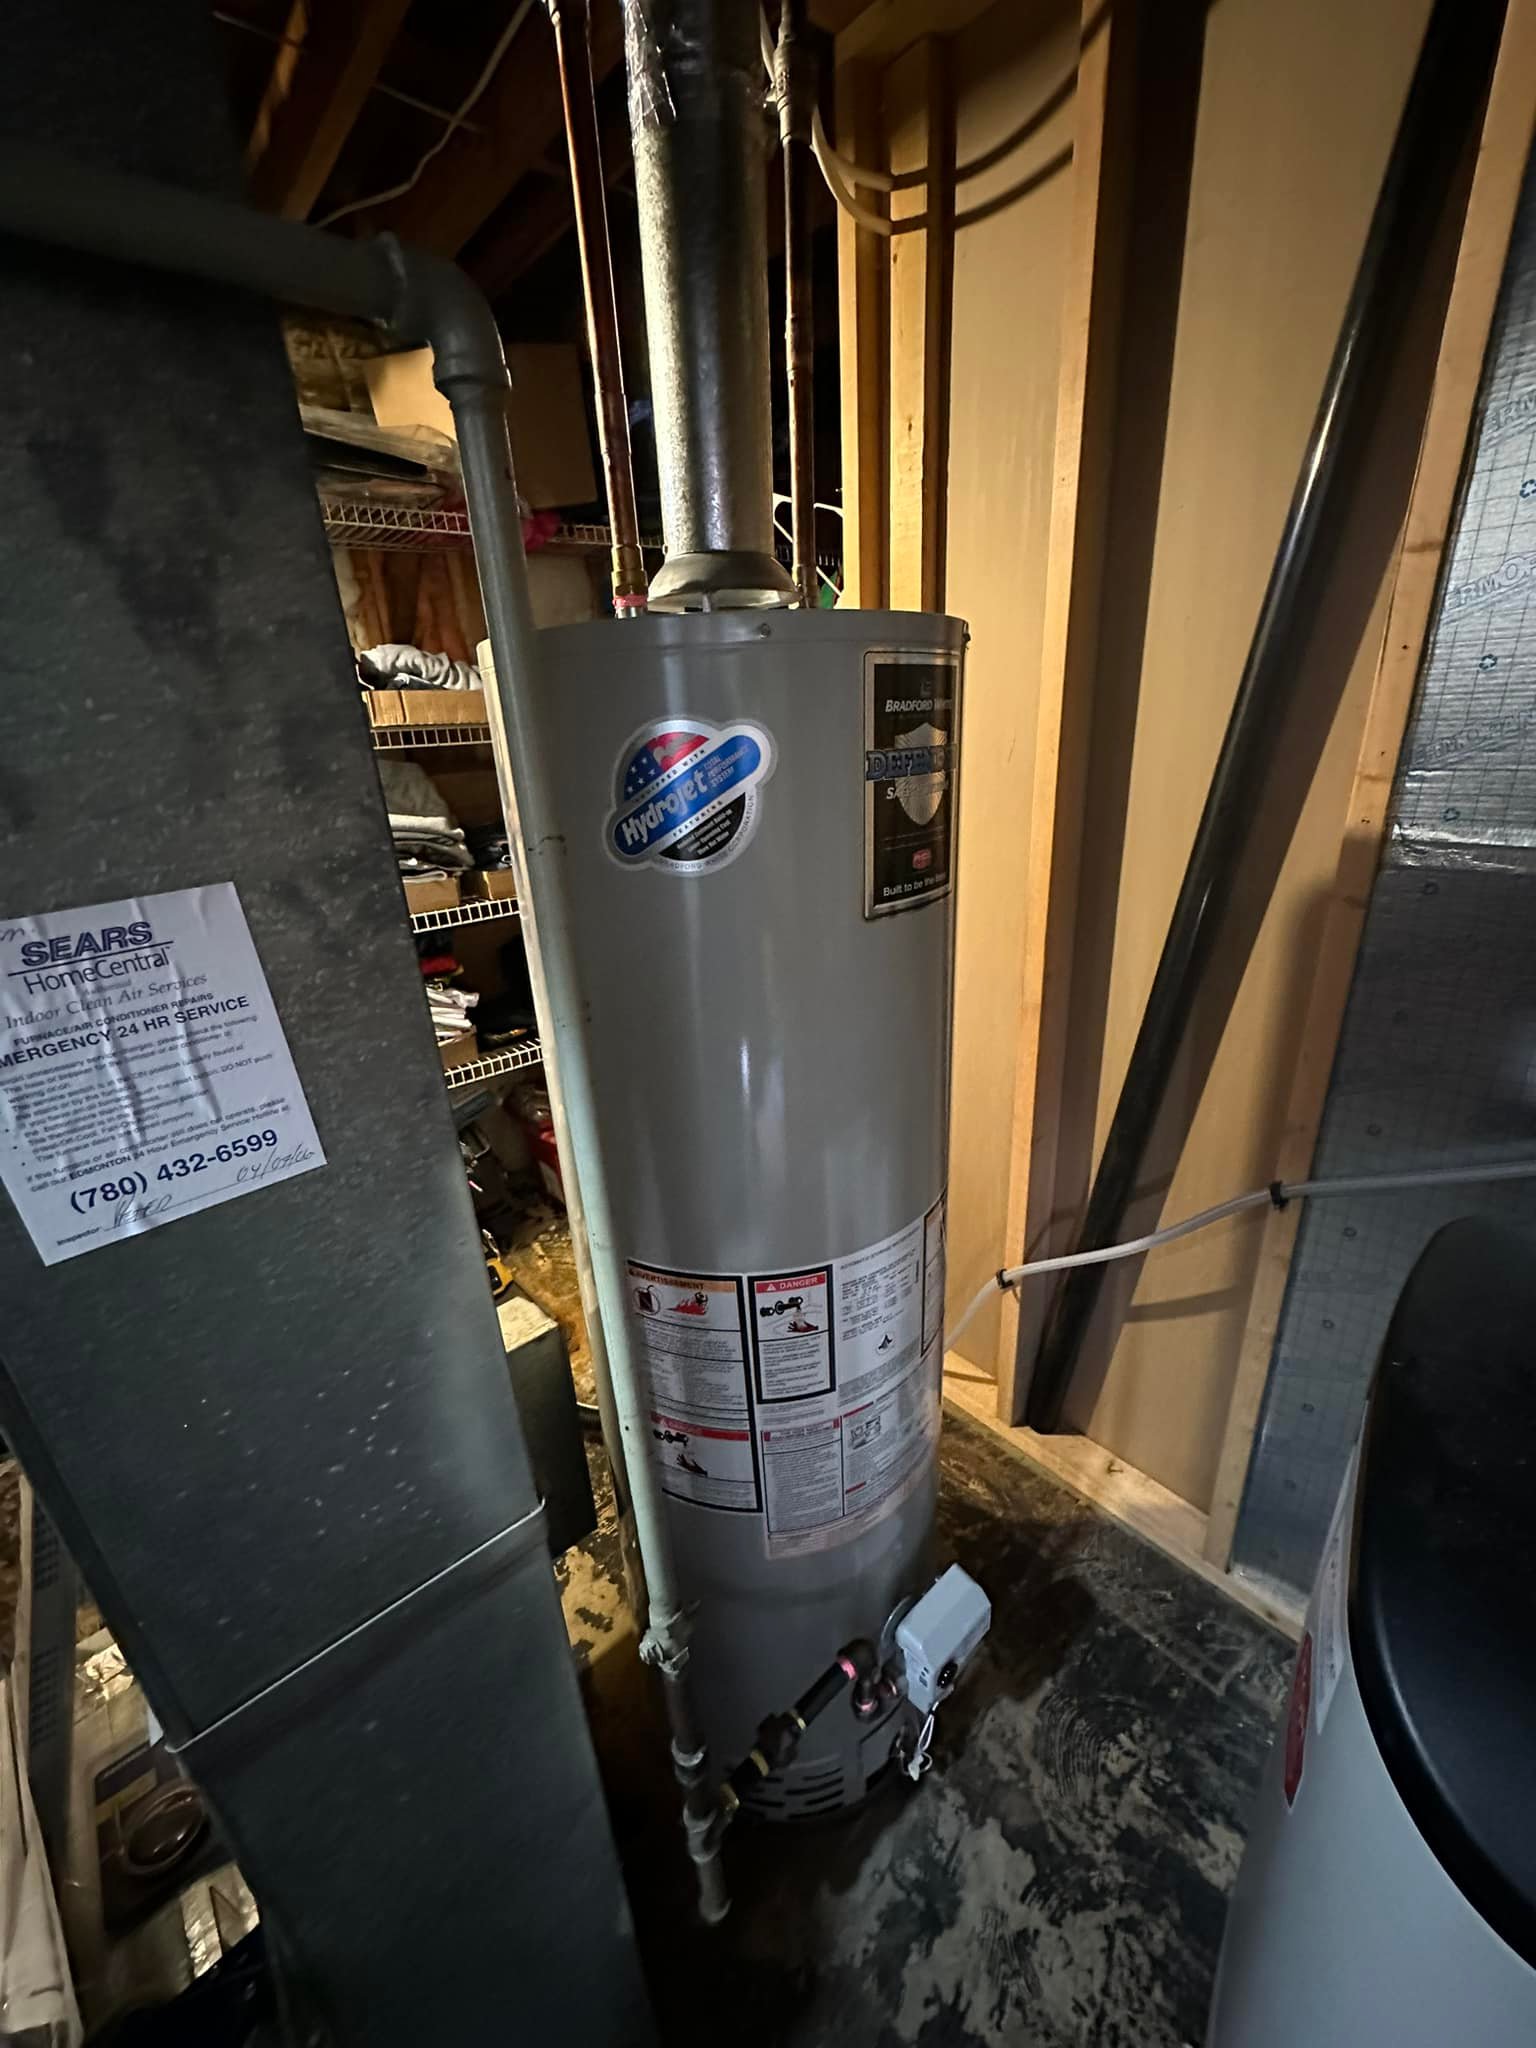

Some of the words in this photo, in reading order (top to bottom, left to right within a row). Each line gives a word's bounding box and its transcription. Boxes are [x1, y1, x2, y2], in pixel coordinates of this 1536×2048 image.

[885, 699, 933, 712] BRADFORD
[672, 800, 723, 837] FEATURING
[21, 921, 153, 967] SEARS
[5, 1009, 60, 1029] Indoor
[66, 995, 112, 1015] Clean
[119, 989, 143, 1004] Air
[148, 974, 208, 997] Services
[96, 1003, 169, 1026] CONDITIONER
[170, 993, 214, 1008] REPAIRS
[117, 1023, 140, 1038] 24
[143, 1015, 171, 1032] HR
[174, 996, 250, 1023] SERVICE
[68, 1154, 132, 1180] EDMONTON
[70, 1171, 148, 1215] (780)
[156, 1129, 278, 1181] 432-6599
[779, 1276, 818, 1290] DANGER
